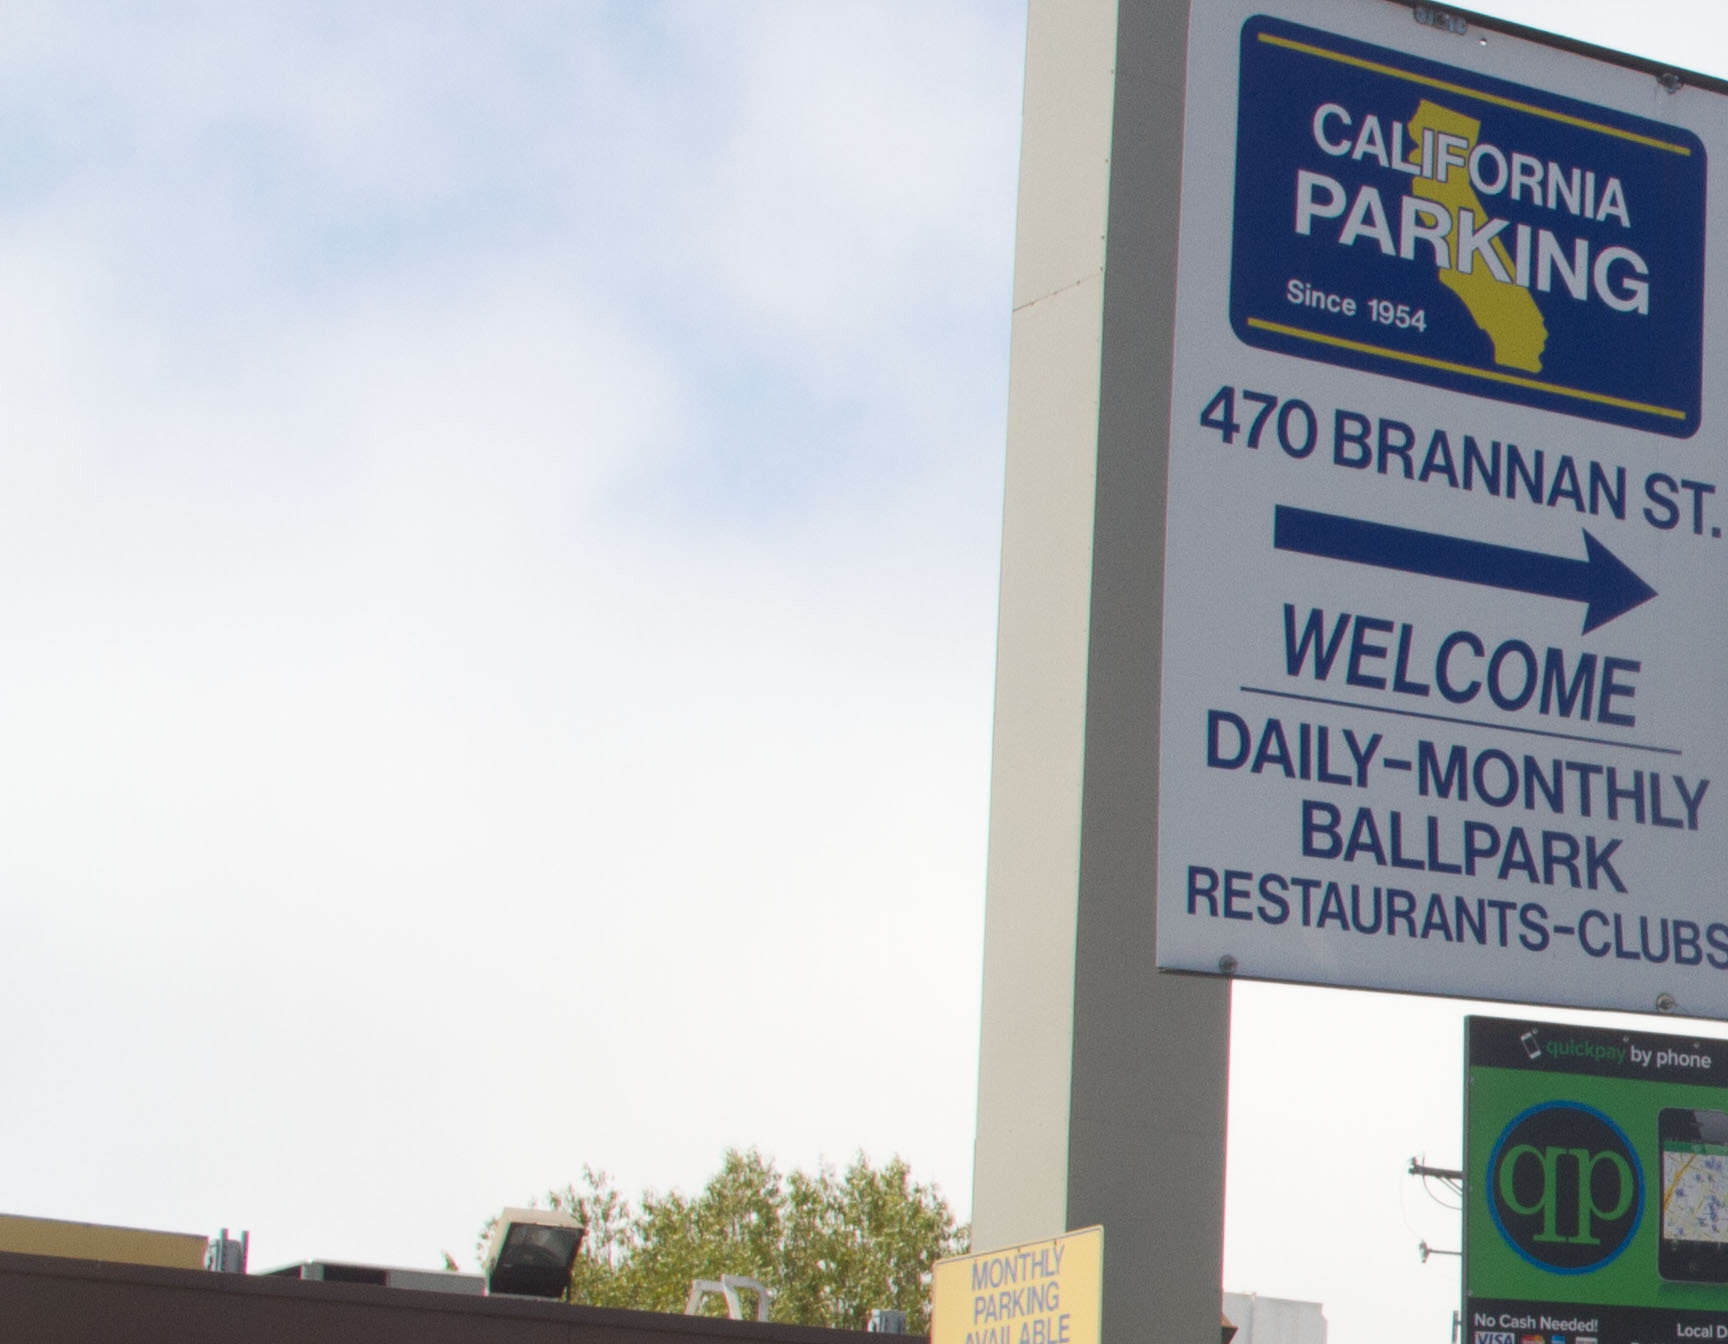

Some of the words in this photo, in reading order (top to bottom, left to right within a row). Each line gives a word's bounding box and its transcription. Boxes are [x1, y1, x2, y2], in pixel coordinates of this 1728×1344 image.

[1312, 102, 1631, 228] CALIFORNIA
[1295, 169, 1651, 315] PARKING
[1287, 279, 1357, 316] Since
[1367, 298, 1427, 333] 1954
[1201, 385, 1318, 460] 470
[1333, 408, 1627, 520] BRANNAN
[1642, 473, 1722, 538] ST.
[1283, 603, 1641, 728] WELCOME
[1207, 709, 1711, 831] DAILY-MONTHLY
[1301, 800, 1629, 895] BALLPARK
[1546, 1040, 1627, 1065] quickpay
[1630, 1046, 1652, 1066] by
[1656, 1049, 1712, 1069] phone
[972, 1245, 1064, 1292] MONTHLY
[973, 1281, 1060, 1325] PARKING
[1474, 1313, 1496, 1327] No
[1499, 1314, 1537, 1329] Cash
[1540, 1316, 1598, 1332] Needed!
[1677, 1323, 1713, 1339] Local
